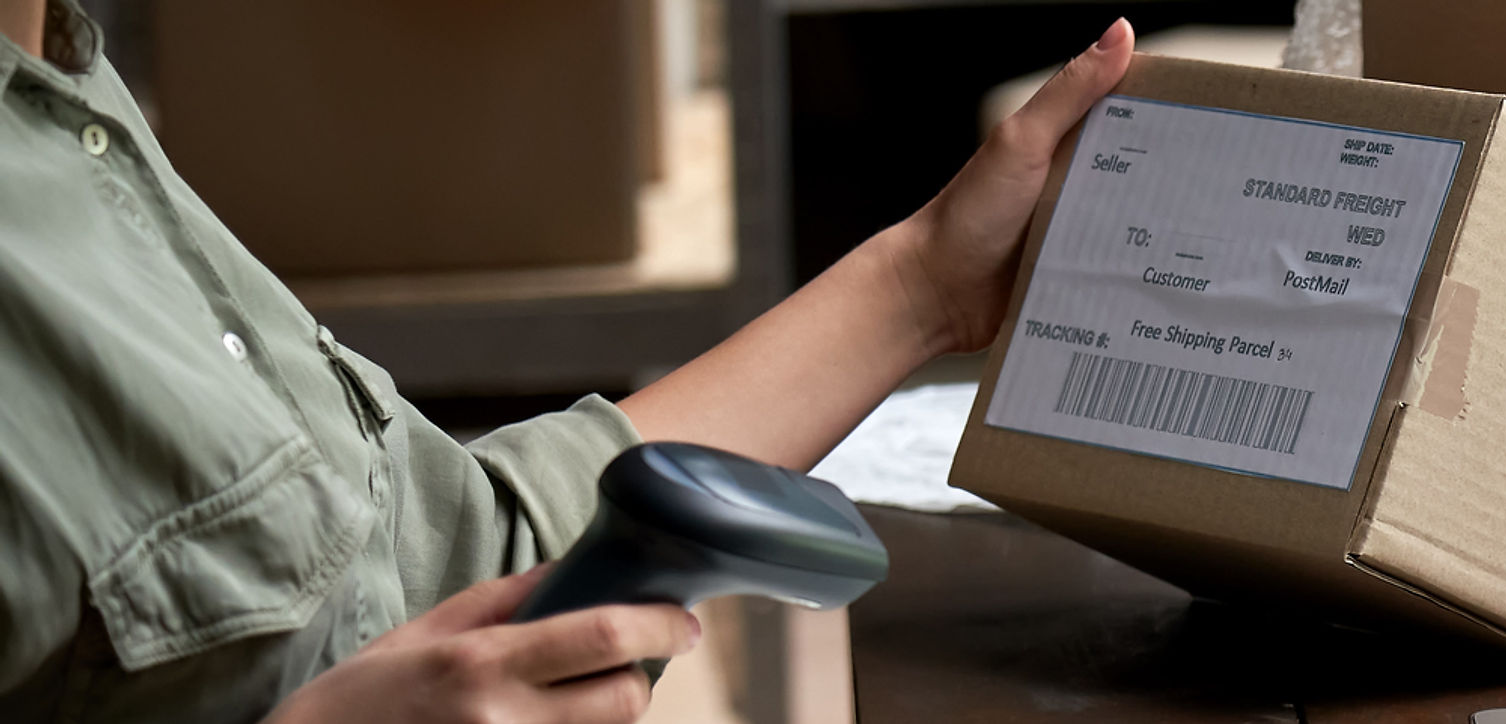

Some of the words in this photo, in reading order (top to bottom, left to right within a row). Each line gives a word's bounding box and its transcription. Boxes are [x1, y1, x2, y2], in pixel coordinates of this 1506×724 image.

[1106, 105, 1135, 119] FROM:
[1344, 138, 1366, 151] SHIP
[1366, 141, 1394, 155] DATE:
[1091, 153, 1132, 174] Seller
[1340, 152, 1379, 168] WEIGHT:
[1243, 178, 1332, 208] STANDARD
[1333, 191, 1406, 218] FREIGHT
[1126, 226, 1152, 247] TO:
[1347, 225, 1385, 246] WED
[1305, 251, 1344, 266] DELIVER
[1345, 256, 1362, 269] BY:
[1143, 266, 1211, 292] Customer
[1283, 270, 1350, 296] PostMail
[1025, 320, 1095, 346] TRACKING
[1131, 320, 1162, 340] Free
[1164, 325, 1226, 355] Shipping
[1228, 336, 1275, 359] Parcel
